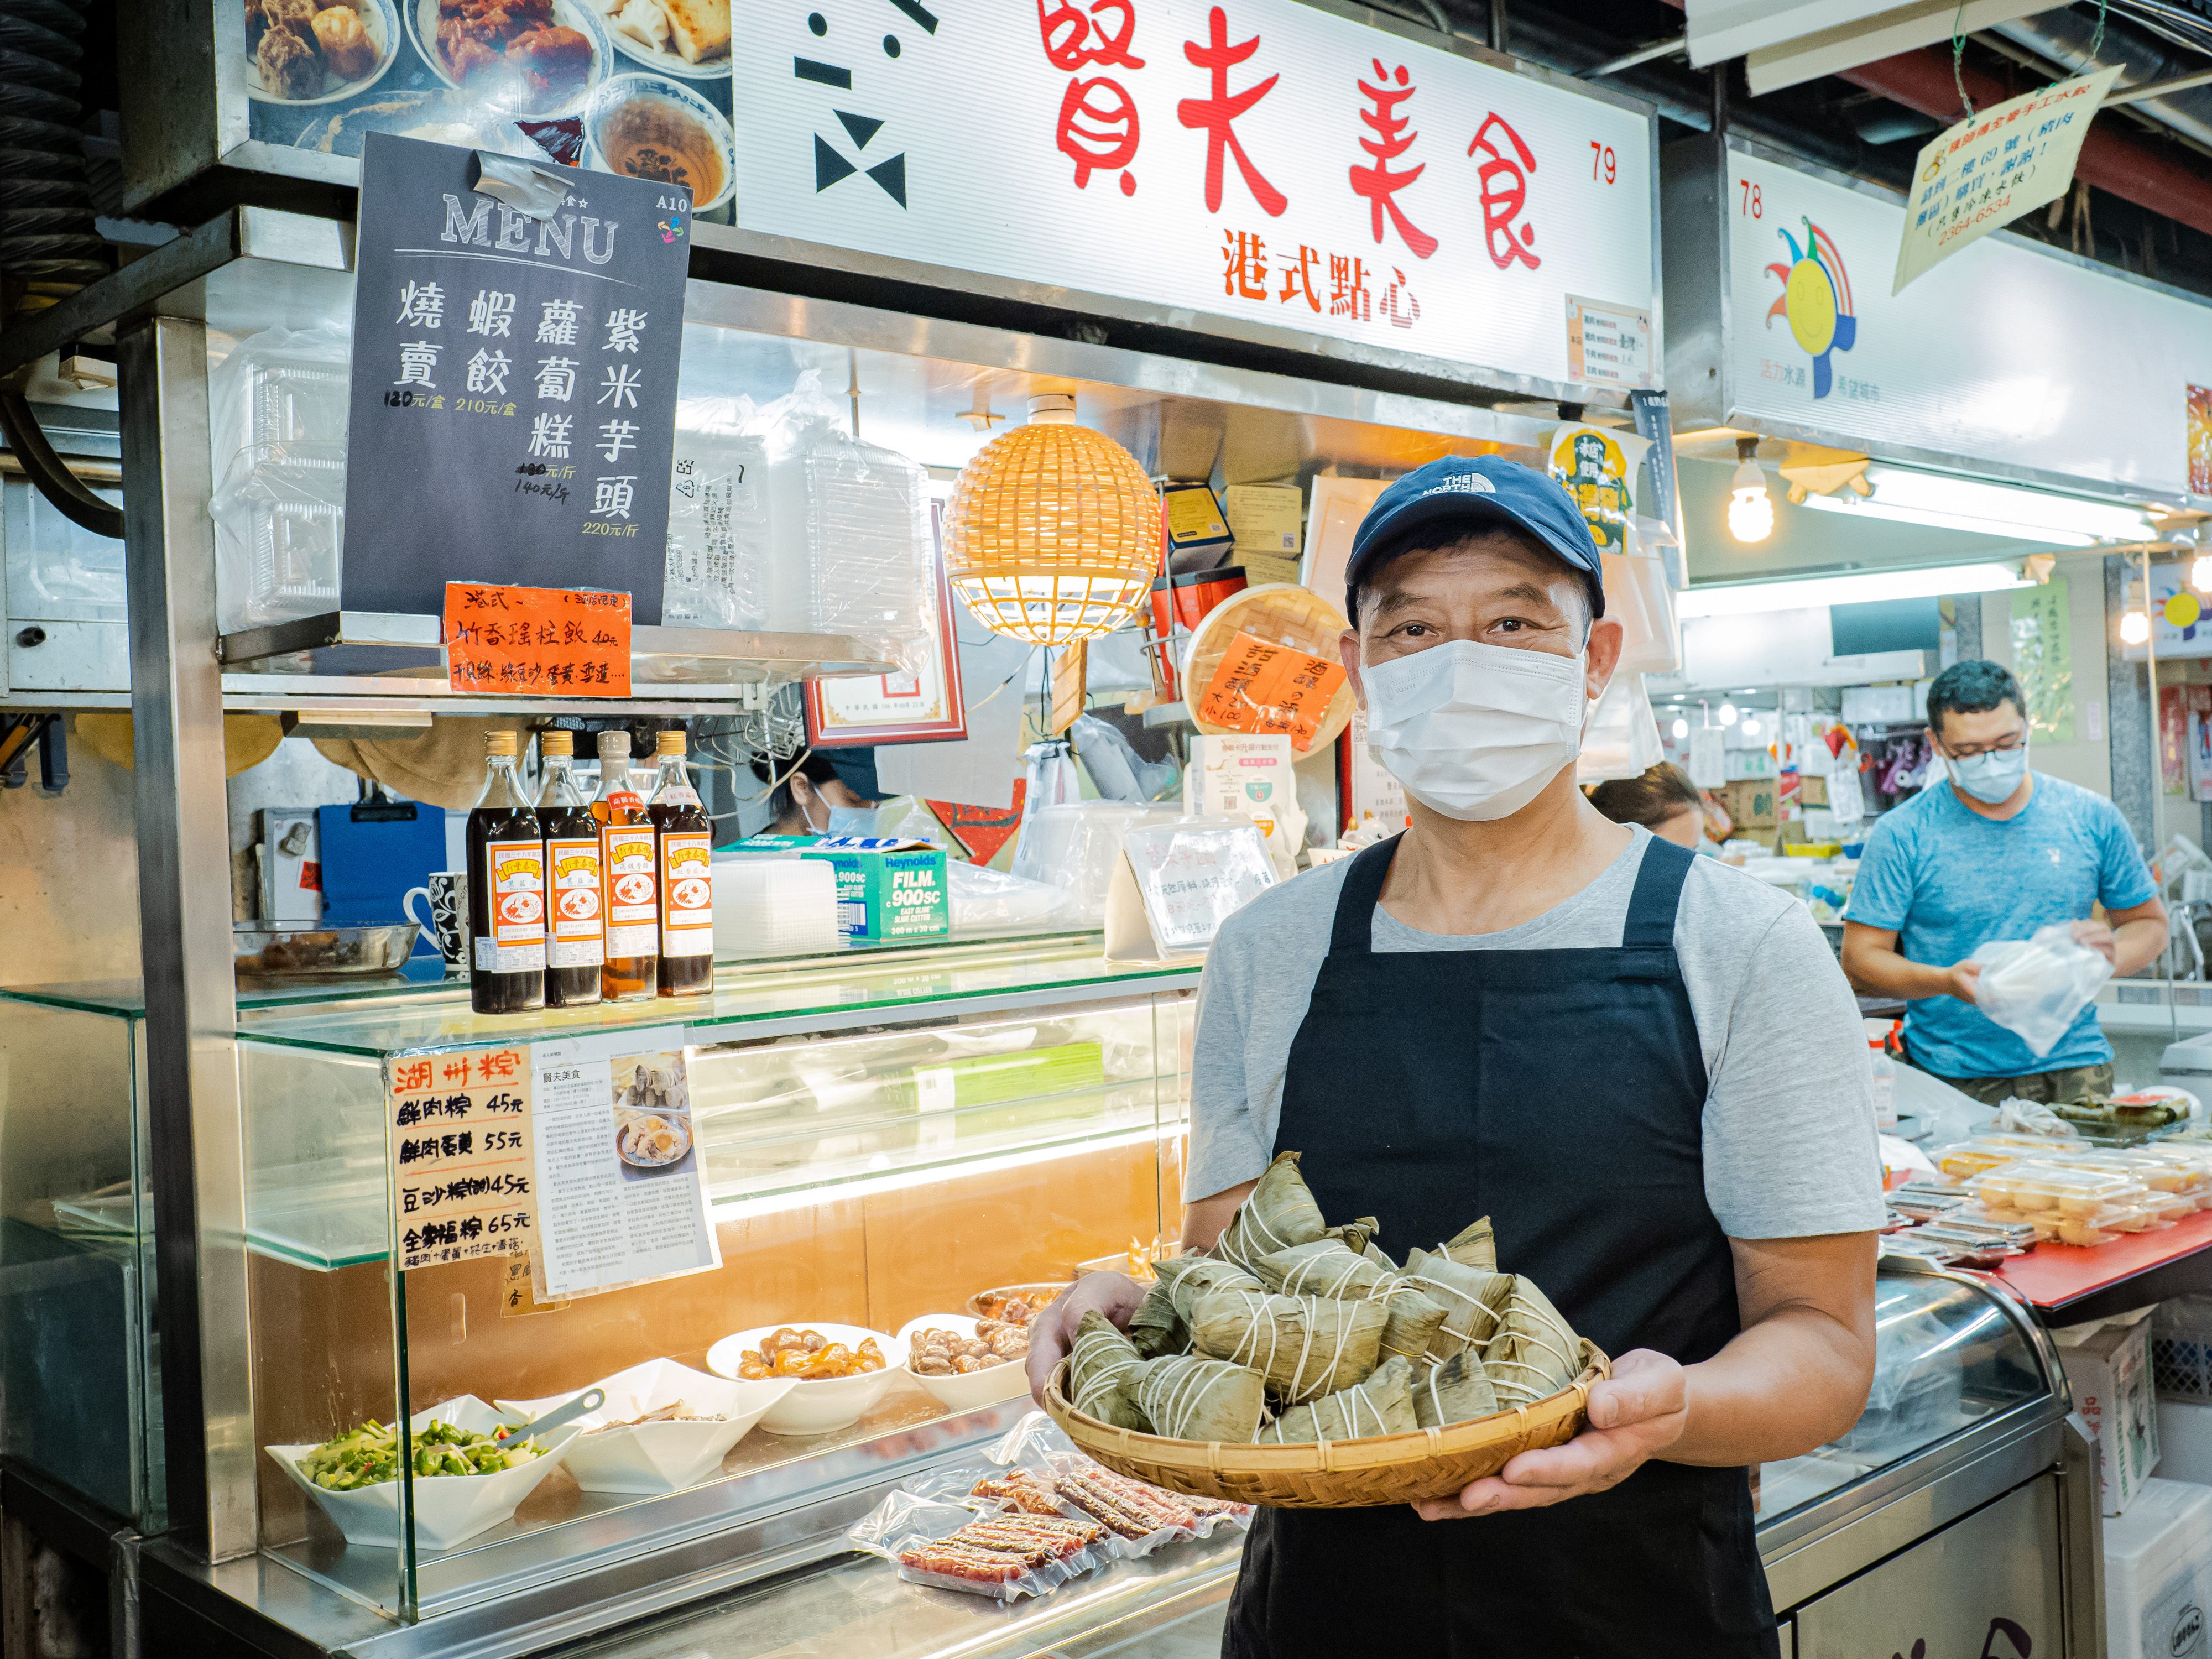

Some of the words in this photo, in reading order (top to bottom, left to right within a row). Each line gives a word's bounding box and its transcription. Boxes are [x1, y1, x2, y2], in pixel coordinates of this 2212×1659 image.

[1037, 0, 1541, 270] 賢夫美食
[1590, 141, 1616, 185] 79
[656, 195, 688, 212] A10
[1740, 180, 1762, 219] 78
[441, 194, 619, 264] MENU
[1938, 194, 2012, 247] 2364-6534
[1222, 228, 1421, 330] 港式點心
[394, 279, 445, 388] 燒賣
[467, 290, 516, 396] 蝦餃
[528, 299, 584, 459] 蘿蔔糕
[455, 398, 517, 416] 210元/盒
[589, 308, 648, 519] 紫米芋頭
[1422, 483, 1470, 496] NORTH
[1442, 474, 1472, 486] THE
[582, 521, 639, 538] 220元/斤
[592, 630, 619, 646] 40元
[833, 858, 862, 870] ynolds
[885, 855, 936, 870] Reynolds
[891, 926, 905, 935] 300
[910, 913, 930, 922] CUTTER
[394, 1050, 520, 1094] 湖州粽
[543, 1069, 580, 1083] 賢夫美食
[397, 1092, 472, 1126] 鮮肉粽
[486, 1093, 524, 1113] 45元
[399, 1130, 473, 1164] 鮮肉蛋黃
[484, 1131, 523, 1151] 55元
[490, 1173, 530, 1195] 45元
[403, 1215, 483, 1253] 全家福粽
[488, 1213, 531, 1234] 65元
[508, 1288, 523, 1307] 香
